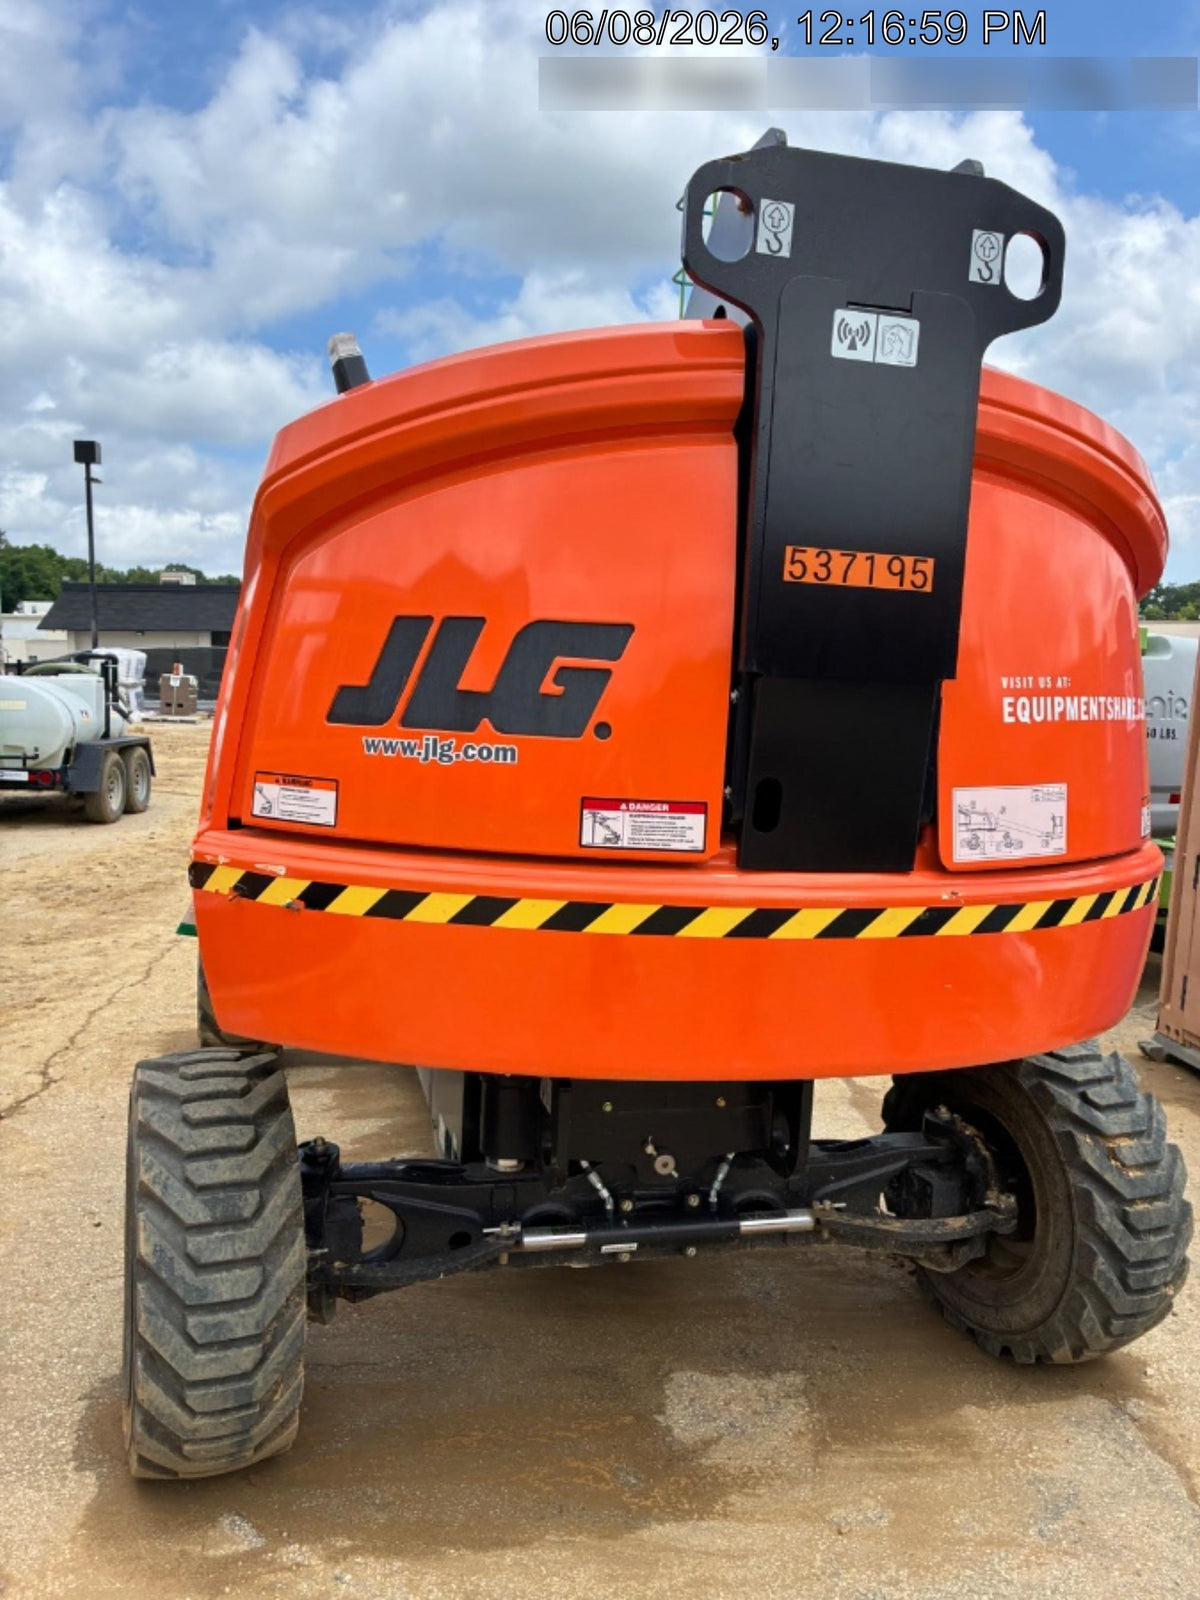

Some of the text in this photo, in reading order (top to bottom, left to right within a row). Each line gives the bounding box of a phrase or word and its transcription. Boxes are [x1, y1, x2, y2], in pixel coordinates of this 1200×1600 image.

[788, 548, 928, 589] 537195
[1001, 676, 1072, 689] VISIT US AT:
[363, 736, 519, 764] www.jlg.com
[628, 803, 670, 812] DANGER
